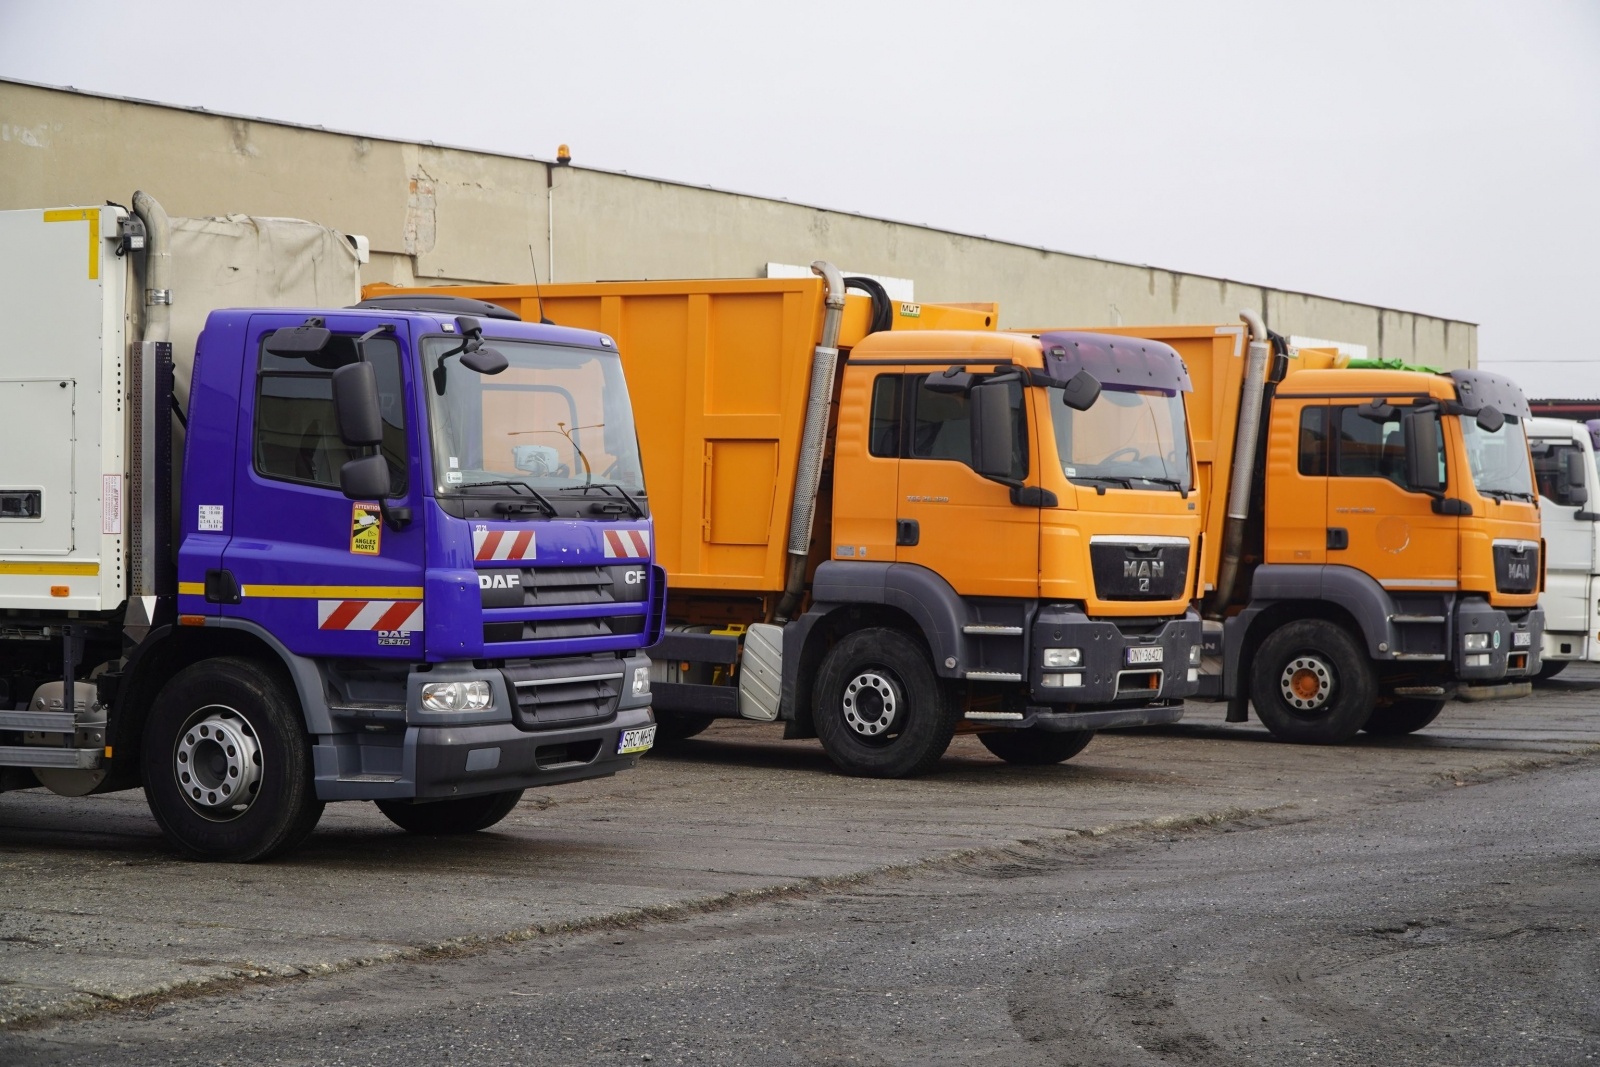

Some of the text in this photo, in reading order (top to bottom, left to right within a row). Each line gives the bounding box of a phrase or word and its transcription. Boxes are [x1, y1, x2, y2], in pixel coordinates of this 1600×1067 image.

[901, 304, 920, 313] MUT
[1123, 561, 1164, 577] MAN
[1508, 563, 1530, 579] MAN
[478, 574, 520, 589] DAF
[625, 570, 646, 585] CF
[1145, 648, 1163, 661] 36427
[623, 731, 640, 748] SRC
